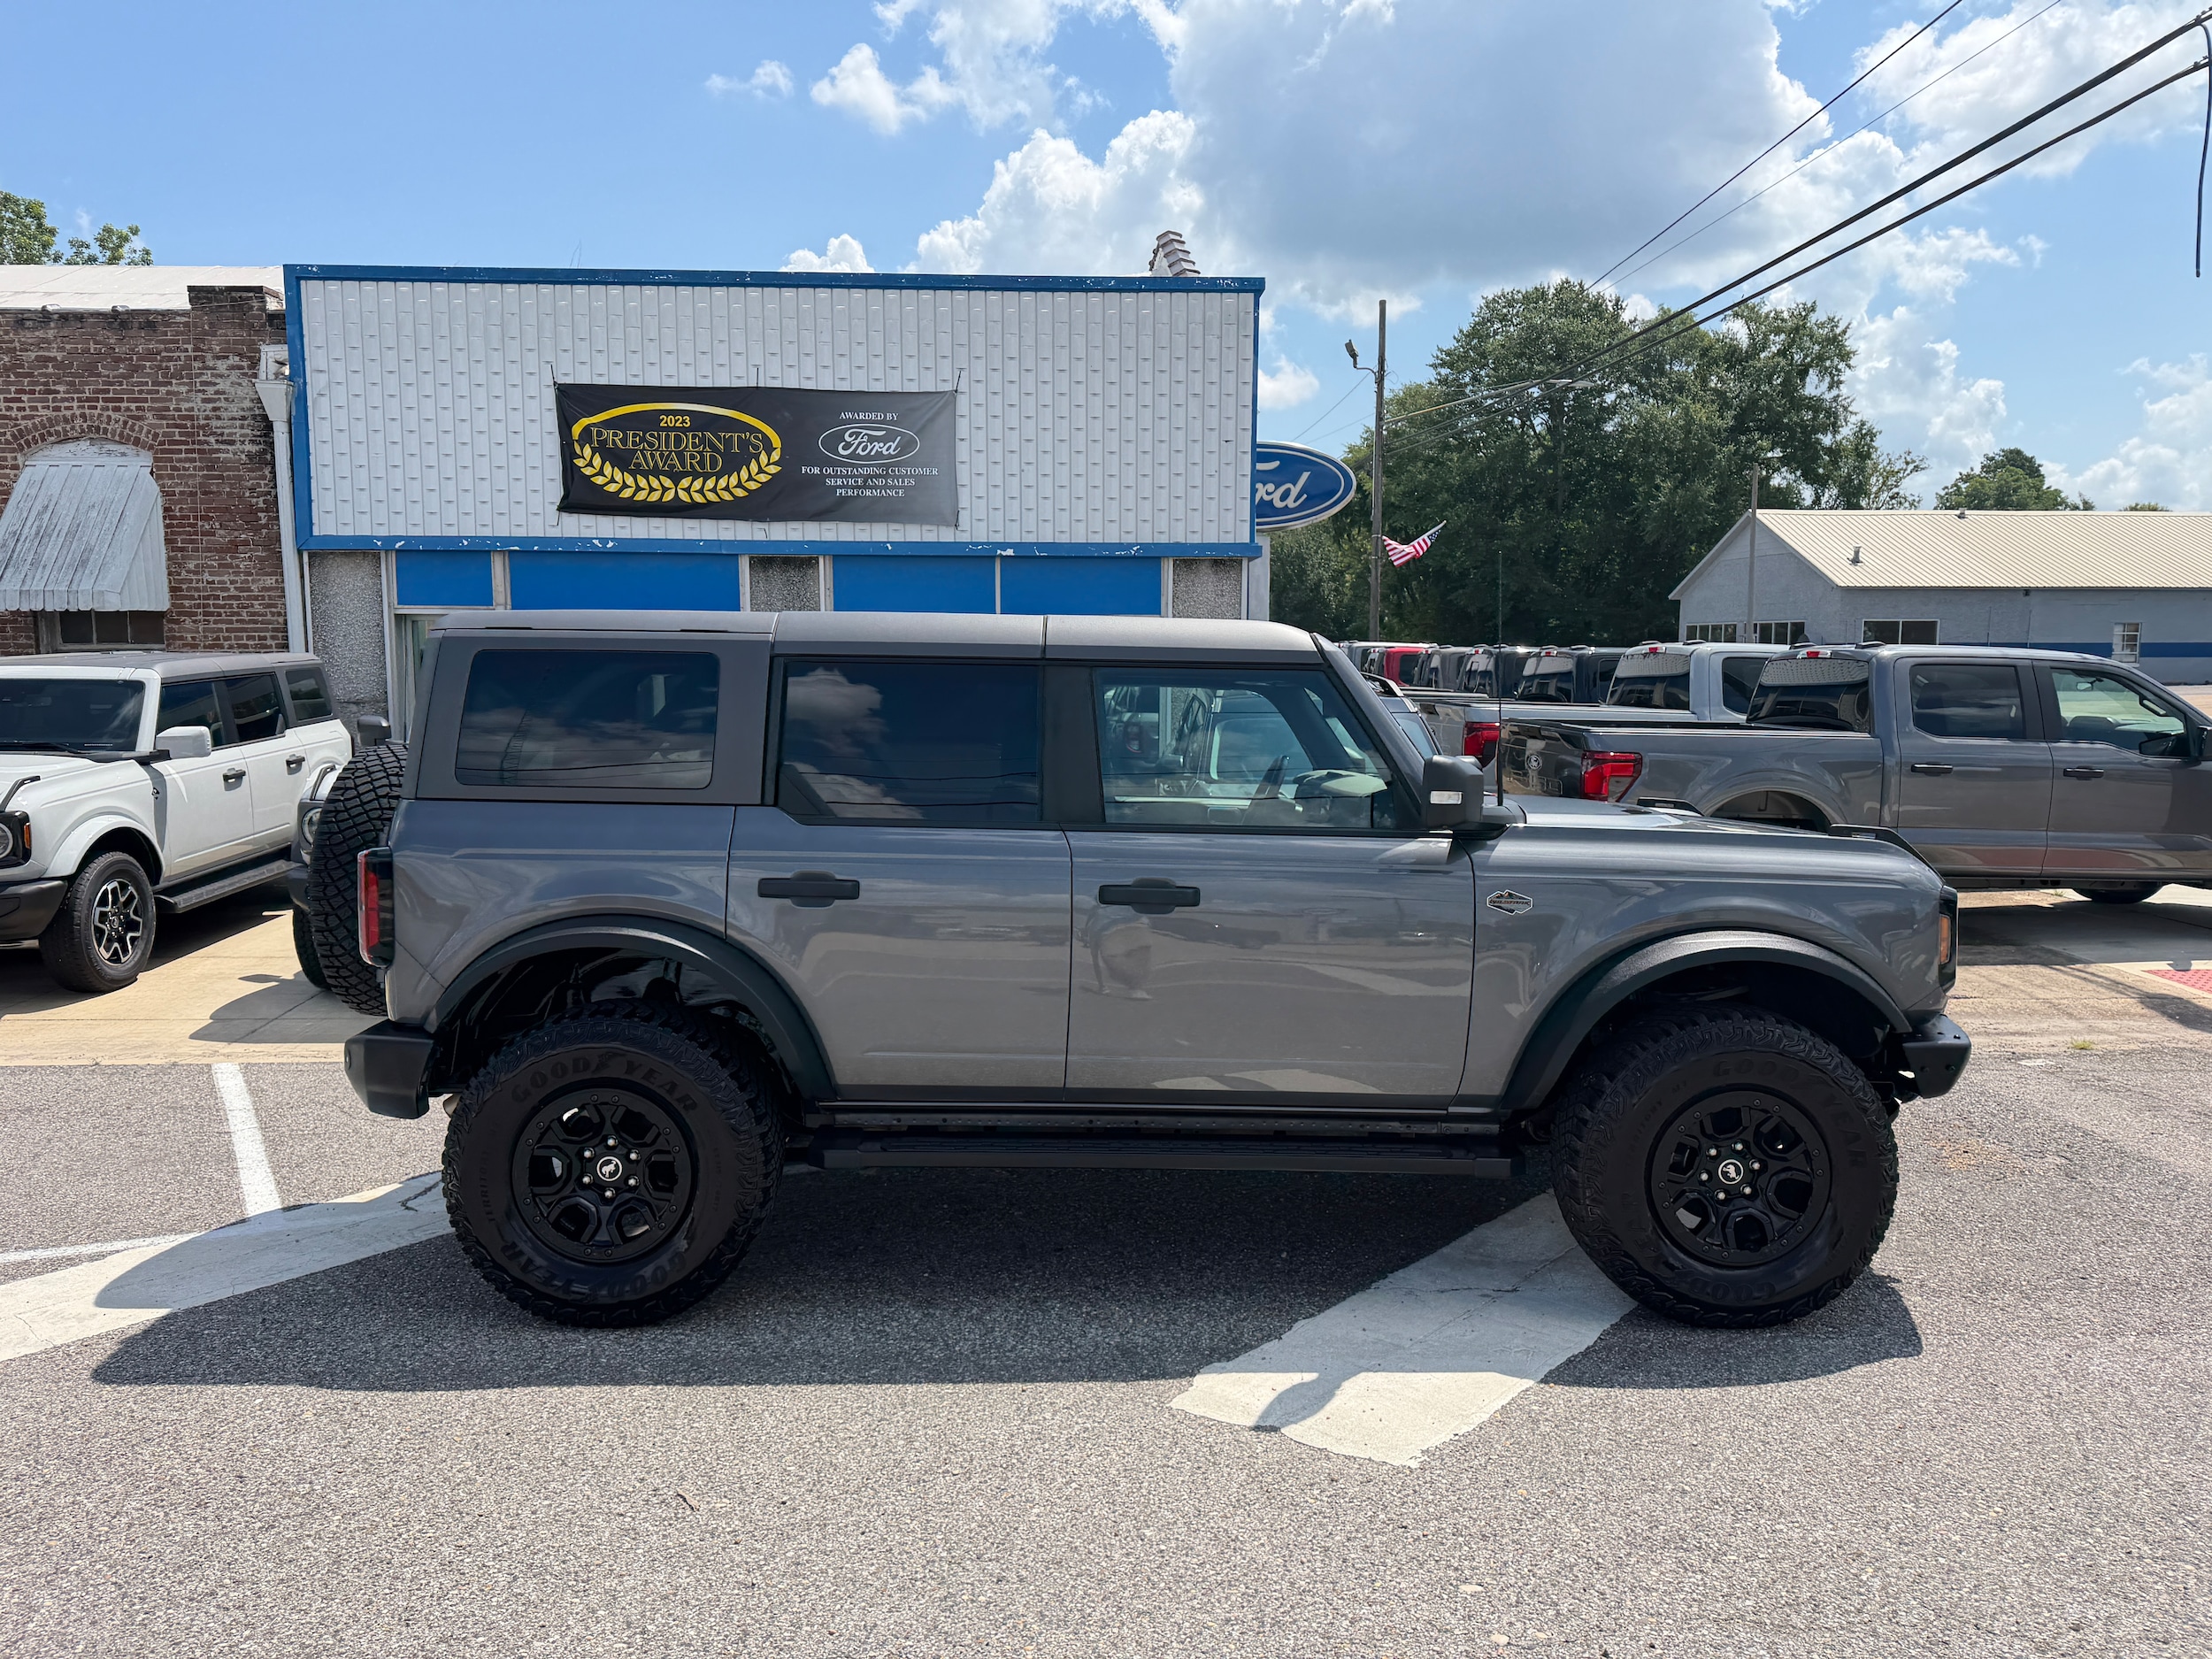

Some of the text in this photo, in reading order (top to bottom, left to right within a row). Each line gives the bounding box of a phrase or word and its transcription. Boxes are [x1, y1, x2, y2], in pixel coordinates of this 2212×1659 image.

[659, 415, 691, 427] 2023
[839, 411, 899, 421] AWARDED BY
[590, 426, 763, 453] PRESIDENT'S
[838, 428, 902, 456] Ford
[629, 450, 723, 472] AWARD
[801, 465, 939, 476] FOR OUTSTANDING CUSTOMER
[826, 478, 916, 487] SERVICE AND SALES
[1256, 460, 1311, 509] rd
[836, 488, 905, 497] PERFORMANCE
